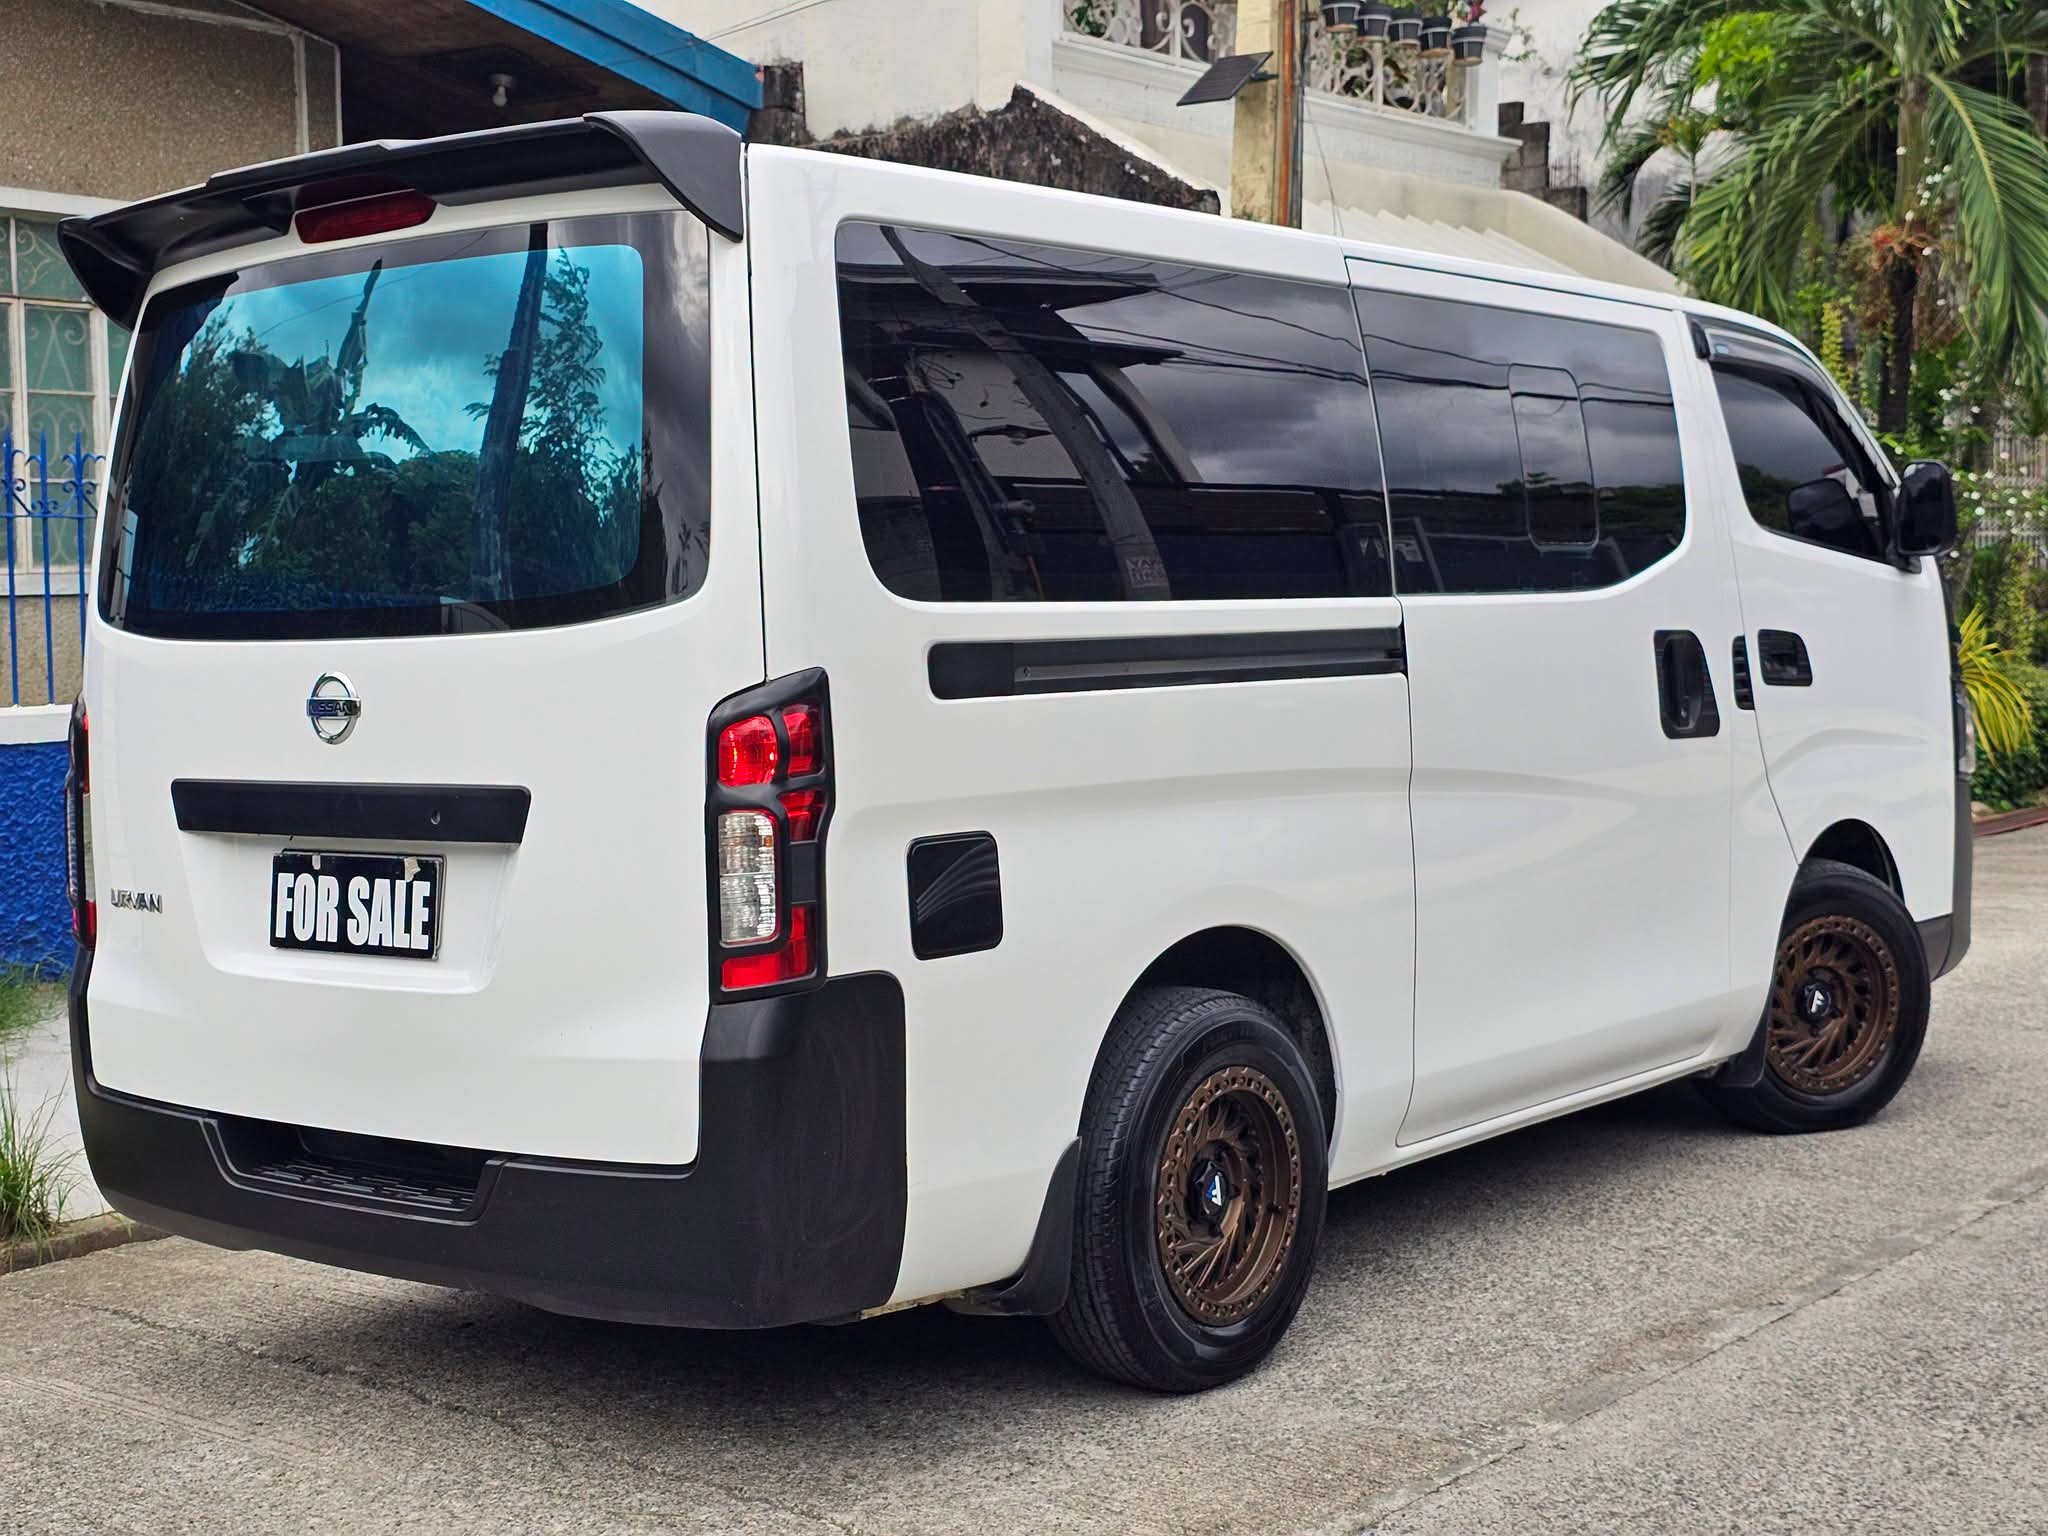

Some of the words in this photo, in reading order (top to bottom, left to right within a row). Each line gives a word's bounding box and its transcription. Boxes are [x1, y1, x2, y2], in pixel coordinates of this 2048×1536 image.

[110, 888, 163, 913] URVAN
[275, 872, 339, 942] FOR
[347, 876, 430, 949] SALE
